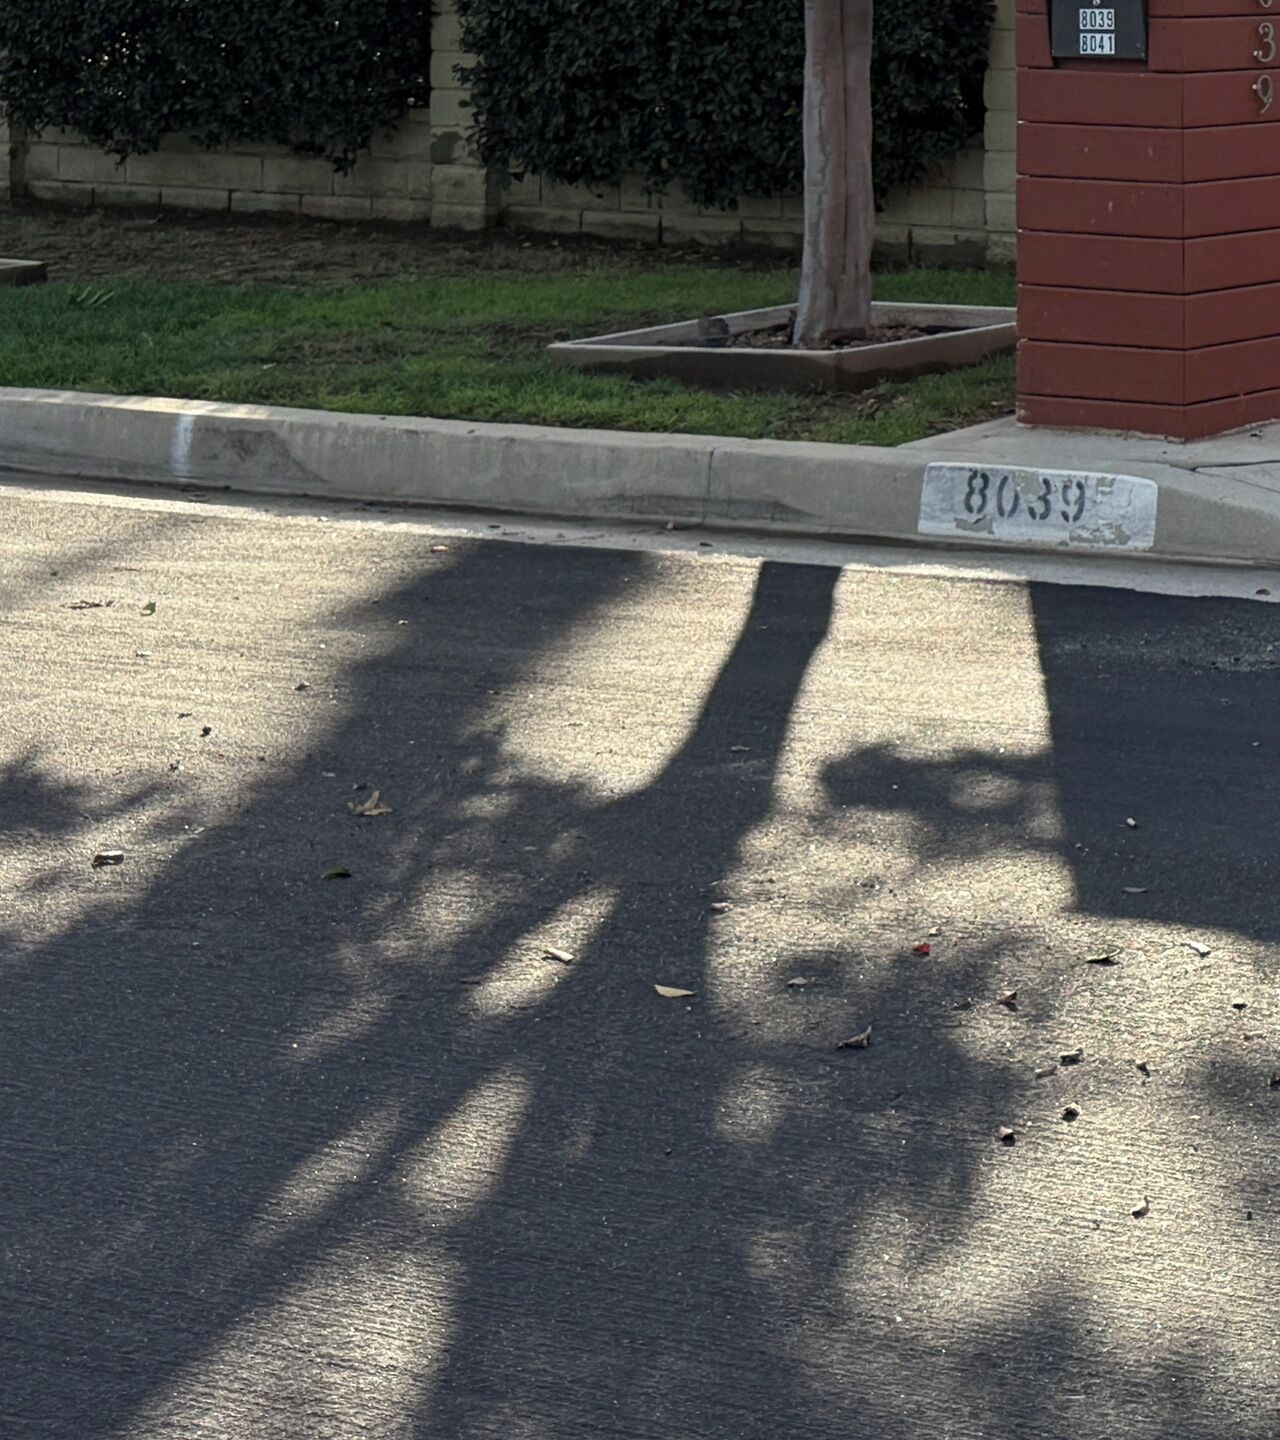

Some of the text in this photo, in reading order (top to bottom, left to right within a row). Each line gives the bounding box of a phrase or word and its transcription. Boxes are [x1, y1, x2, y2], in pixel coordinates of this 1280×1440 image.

[1081, 10, 1113, 28] 8039
[1081, 35, 1113, 52] 8041
[963, 467, 1086, 523] 8039
